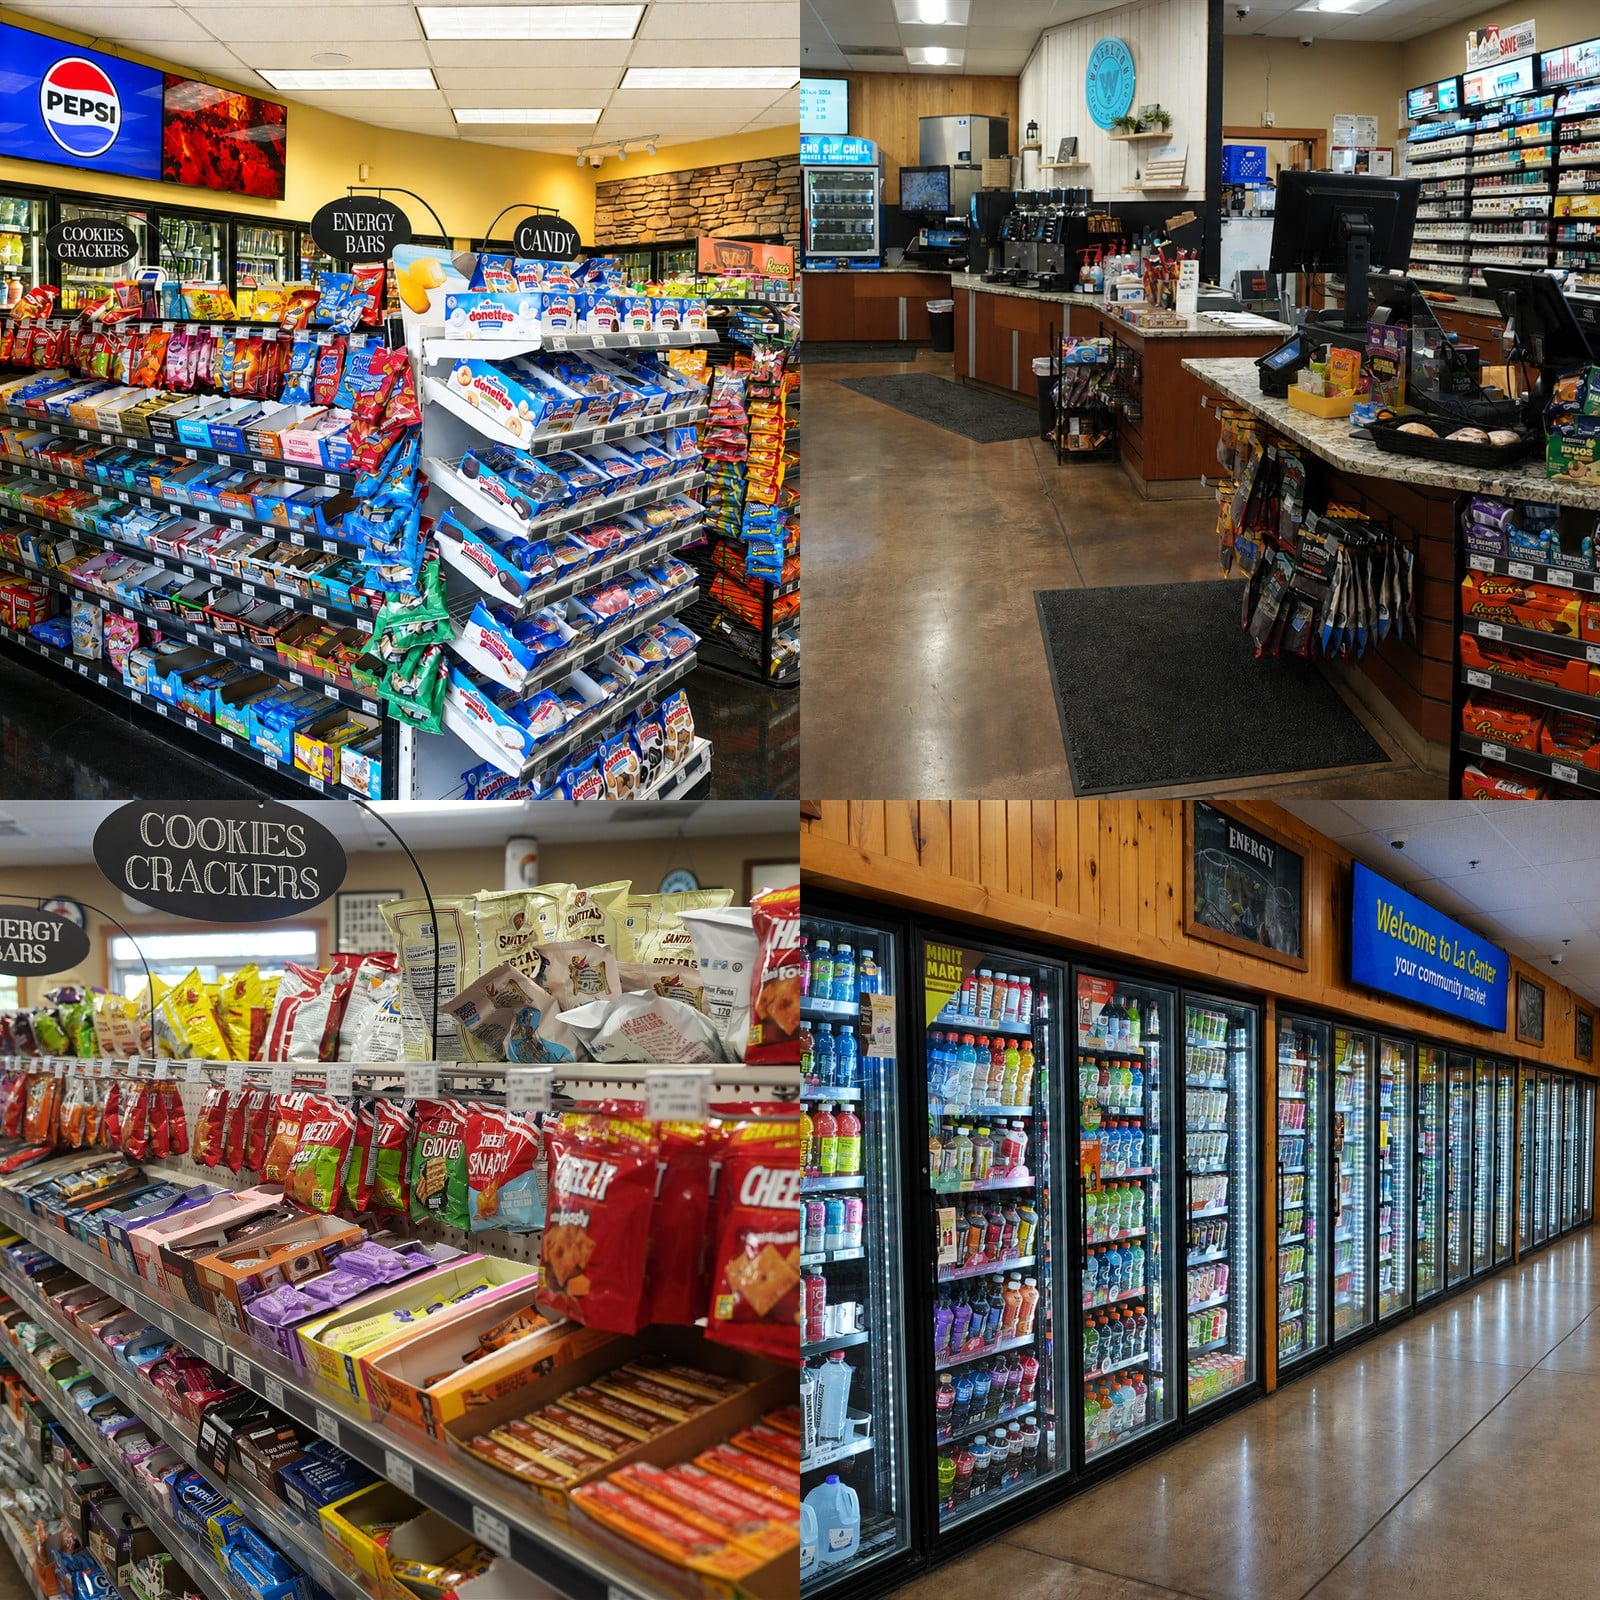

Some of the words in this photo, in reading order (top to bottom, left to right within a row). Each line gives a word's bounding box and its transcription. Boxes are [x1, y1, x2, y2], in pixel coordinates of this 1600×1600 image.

[1500, 36, 1517, 55] SAVE
[47, 90, 116, 124] PEPSI
[823, 144, 839, 153] SIP
[843, 143, 869, 154] CHILL
[332, 212, 395, 232] ENERGY
[62, 226, 124, 243] COOKIES
[345, 234, 385, 253] BARS
[519, 226, 577, 256] CANDY
[57, 242, 130, 258] CRACKERS
[469, 310, 514, 322] donettes
[473, 378, 513, 411] donettes
[1472, 602, 1512, 615] Reese's
[1476, 720, 1522, 743] Reese's
[603, 748, 632, 771] donettes
[140, 812, 307, 858] COOKIES
[1229, 826, 1274, 868] ENERGY
[125, 854, 321, 900] CRACKERS
[568, 907, 602, 928] SANTITAS
[439, 944, 456, 952] FRESH
[1376, 898, 1436, 955] Welcome
[1439, 937, 1451, 963] to
[1454, 940, 1466, 969] La
[1467, 949, 1497, 985] Center
[926, 944, 963, 965] MINIT
[926, 960, 963, 981] MART
[1394, 954, 1417, 977] your
[1417, 965, 1463, 1000] community
[1463, 981, 1486, 1007] market
[716, 987, 734, 996] Facts
[378, 1016, 398, 1024] LAYER
[717, 1007, 731, 1016] 170
[278, 1439, 299, 1452] Whites
[185, 1484, 214, 1504] OREO
